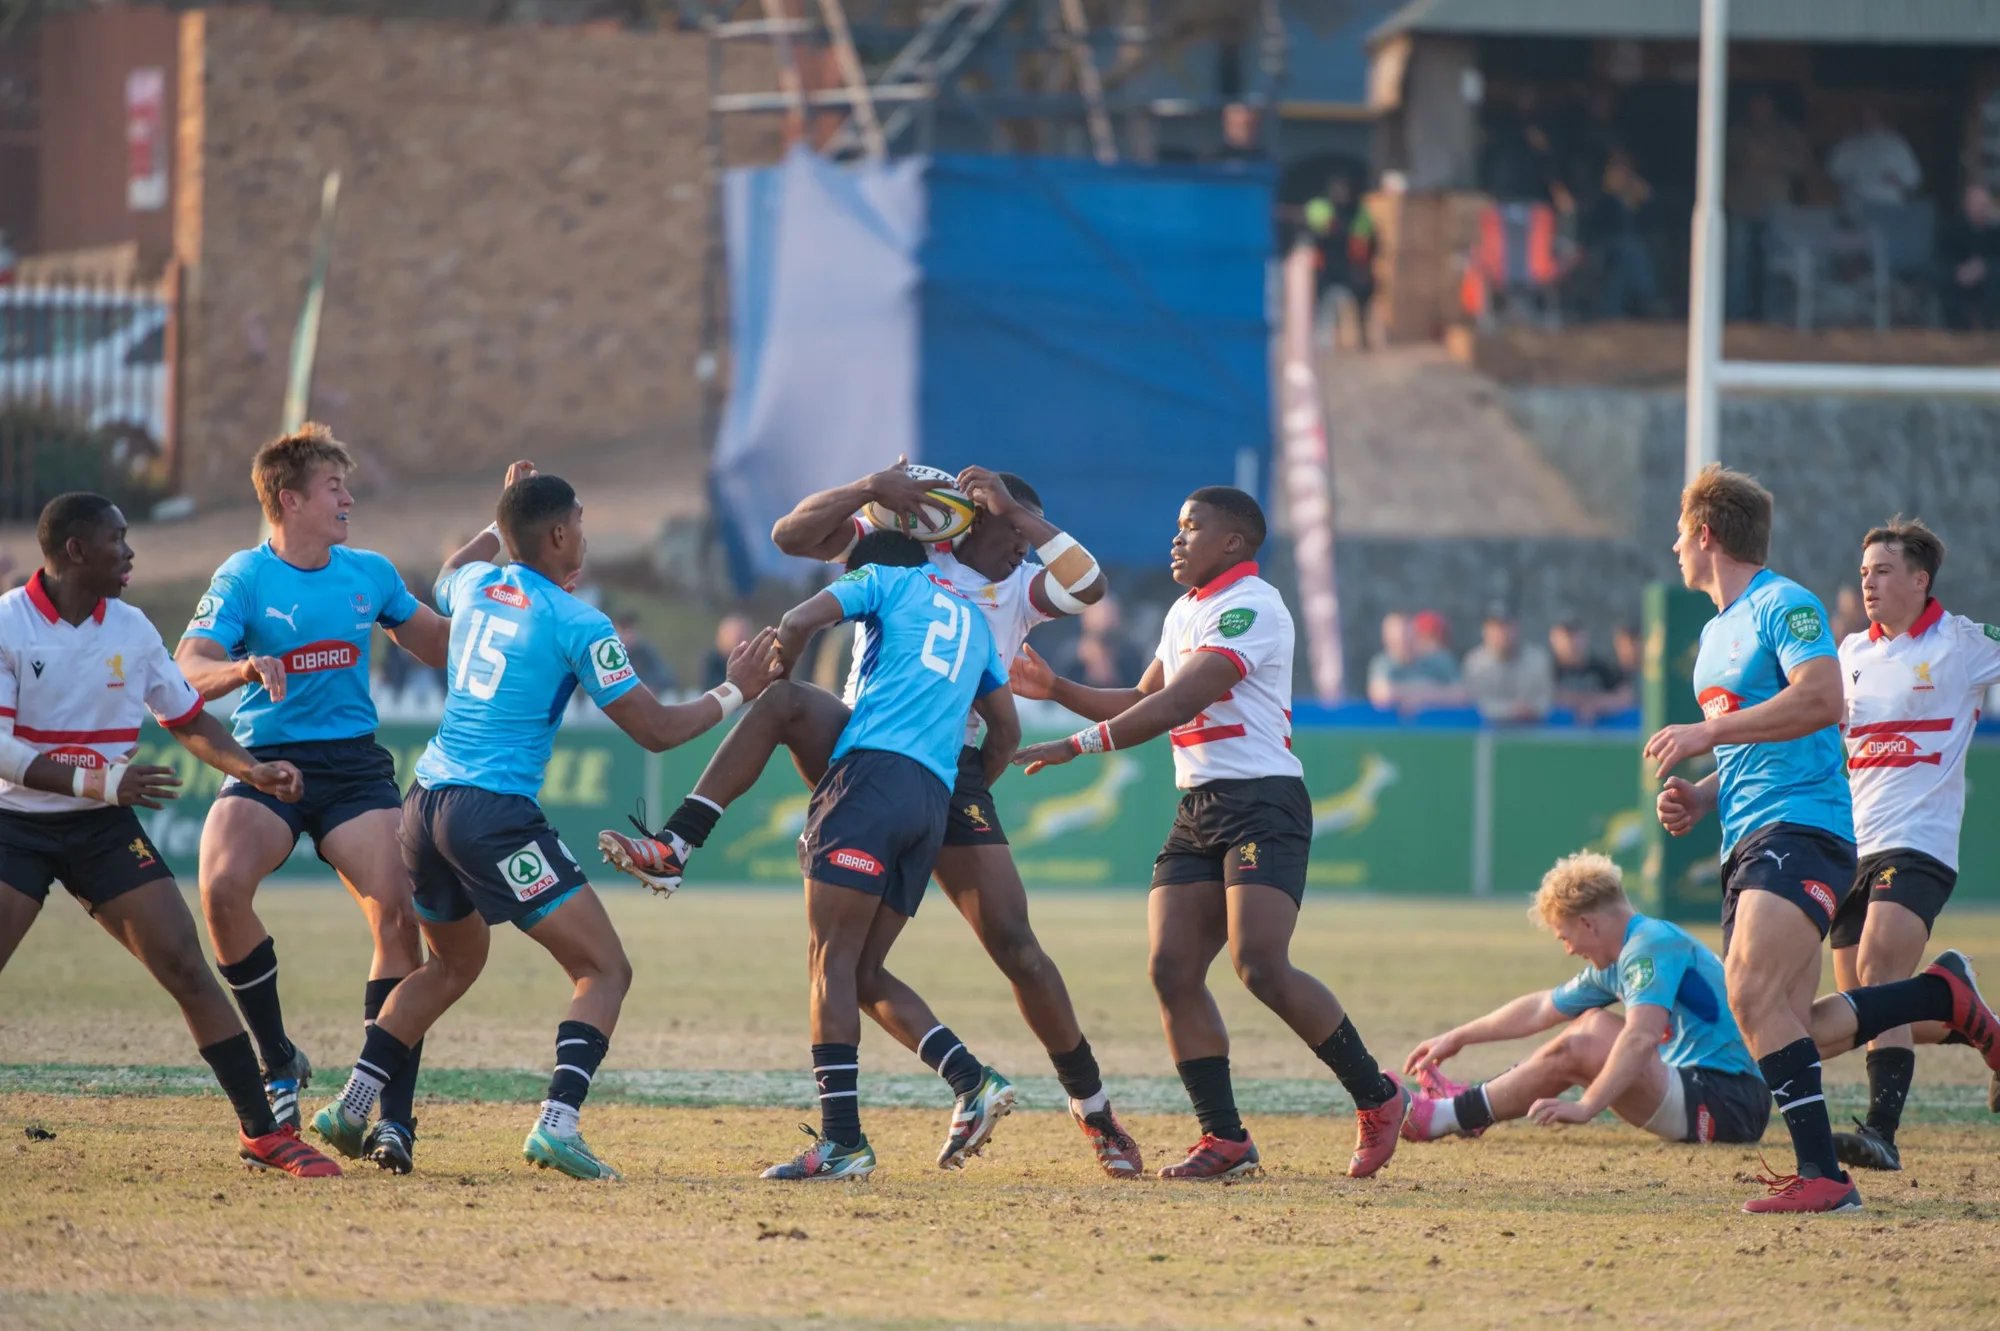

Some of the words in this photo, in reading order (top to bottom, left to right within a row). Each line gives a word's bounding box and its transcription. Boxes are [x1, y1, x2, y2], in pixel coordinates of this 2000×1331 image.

[492, 588, 523, 606] OBARO
[920, 592, 971, 684] 21
[292, 647, 350, 670] OBARO
[455, 609, 519, 701] 15
[1868, 740, 1907, 754] OBARO
[836, 852, 875, 872] OBARO
[520, 875, 555, 899] SPAR
[1810, 884, 1836, 915] OBARO
